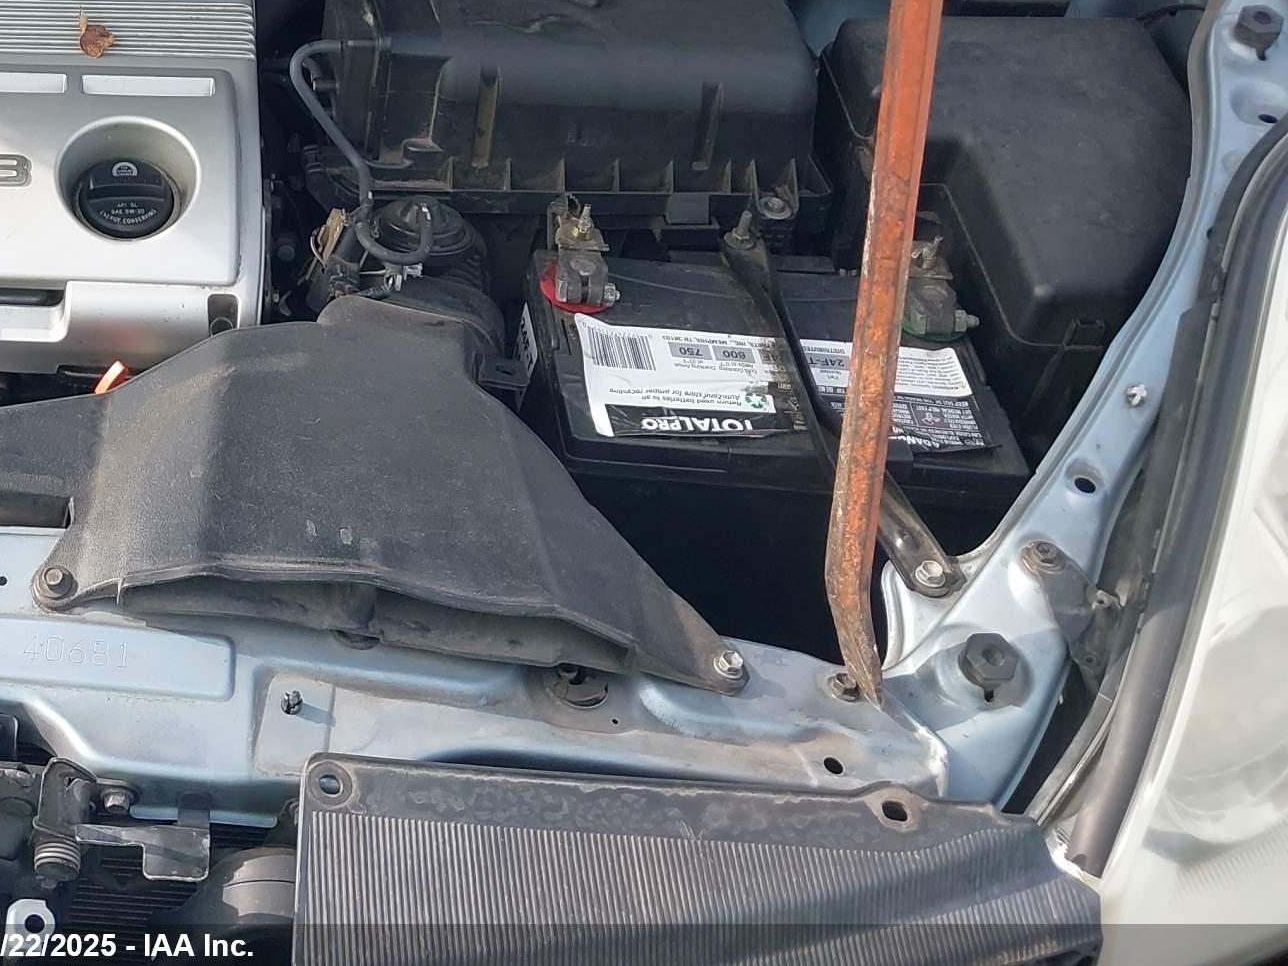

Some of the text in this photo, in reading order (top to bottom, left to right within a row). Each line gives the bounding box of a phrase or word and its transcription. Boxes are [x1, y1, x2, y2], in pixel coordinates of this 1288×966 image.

[679, 346, 703, 357] 750
[722, 349, 746, 359] 600
[808, 356, 845, 367] 24F-T
[609, 387, 643, 395] recycling
[662, 395, 695, 404] batteries
[641, 416, 754, 432] TOTALPRO
